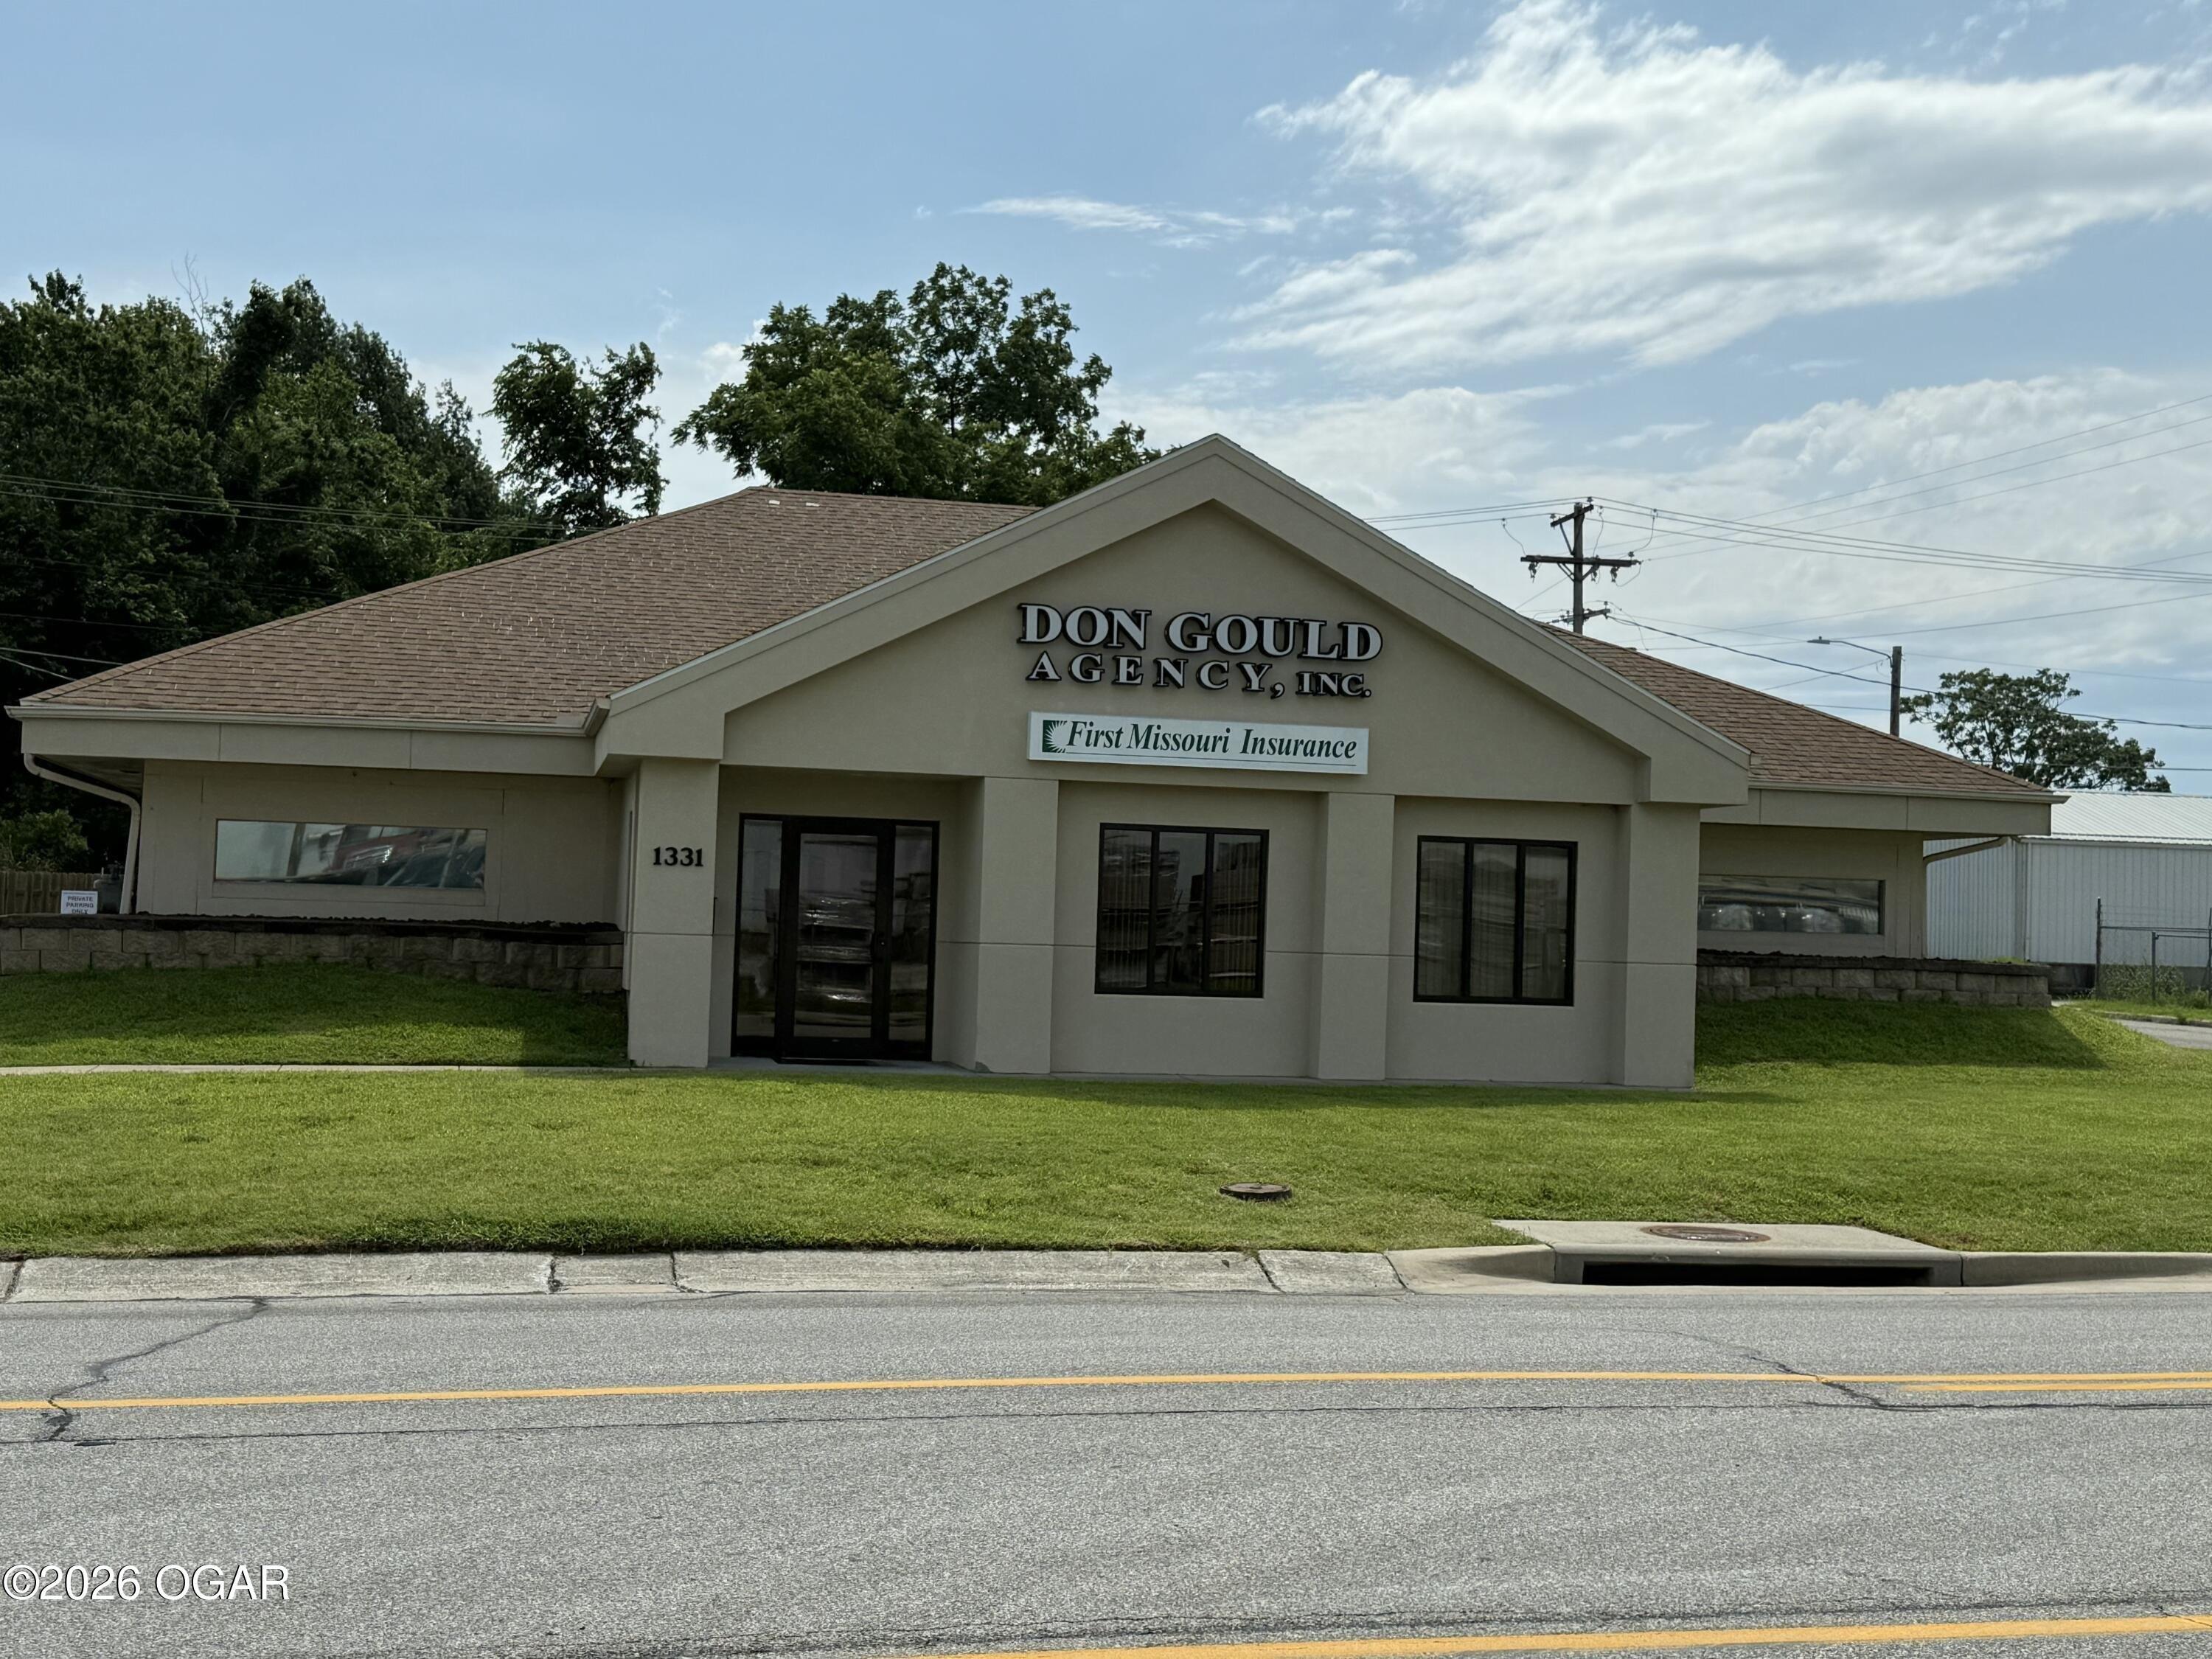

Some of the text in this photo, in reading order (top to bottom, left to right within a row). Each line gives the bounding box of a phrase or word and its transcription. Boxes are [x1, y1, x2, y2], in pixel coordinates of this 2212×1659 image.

[1018, 602, 1383, 661] DON GOULD
[1026, 650, 1372, 699] AGENCY, INC.
[1066, 720, 1357, 759] First Missouri Insurance
[653, 846, 704, 867] 1331
